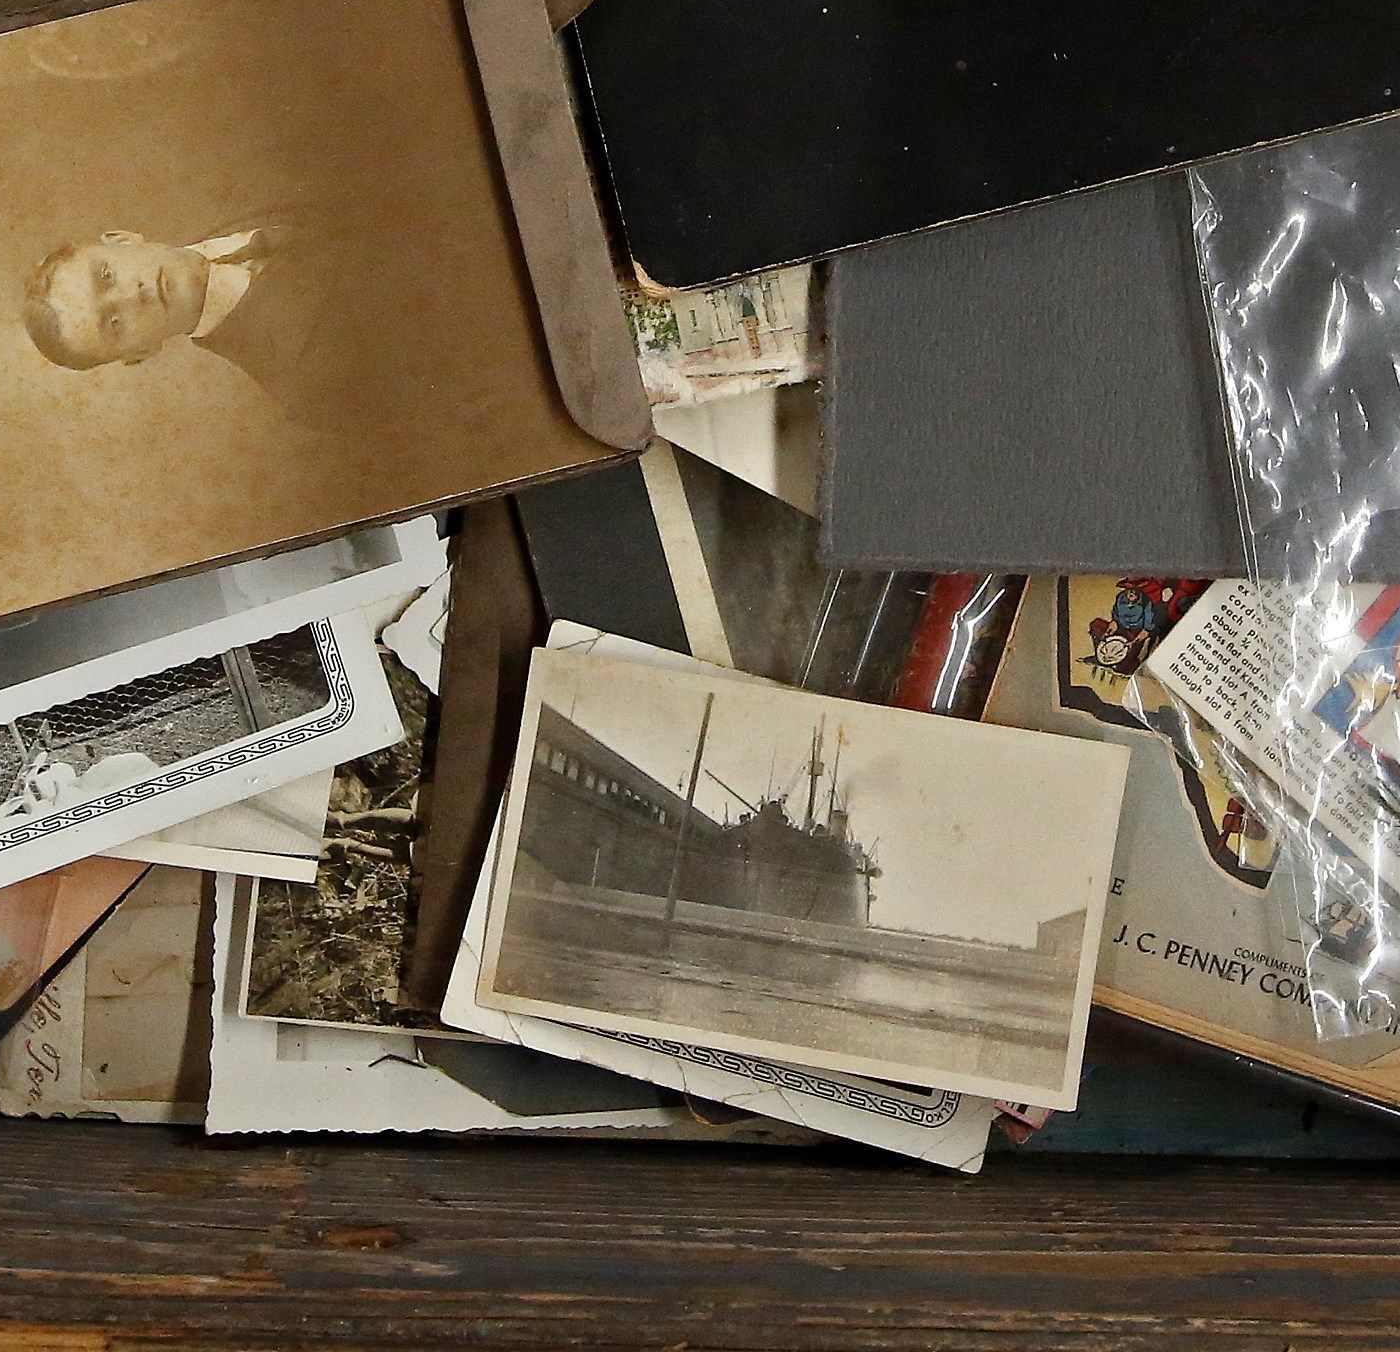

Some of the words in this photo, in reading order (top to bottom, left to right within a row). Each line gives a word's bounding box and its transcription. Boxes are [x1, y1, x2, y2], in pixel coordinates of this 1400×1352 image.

[1211, 613, 1238, 637] about
[1220, 602, 1244, 625] each
[1194, 634, 1213, 651] one
[1211, 648, 1229, 665] end
[1229, 663, 1242, 676] of
[1203, 622, 1227, 645] Press
[1225, 642, 1242, 658] flat
[1241, 655, 1260, 674] and
[1167, 662, 1203, 695] through
[1204, 694, 1221, 710] slot
[1223, 711, 1231, 719] B
[1233, 720, 1255, 741] from
[1177, 652, 1200, 674] front
[1202, 675, 1213, 685] to
[1214, 685, 1241, 711] back,
[1184, 643, 1220, 675] through
[1220, 674, 1238, 690] slot
[1239, 691, 1248, 699] A
[1249, 699, 1272, 720] from
[1112, 924, 1129, 947] J.
[1135, 932, 1157, 956] C.
[1162, 939, 1255, 986] PENNEY
[1233, 946, 1308, 979] COMPLIMENTS
